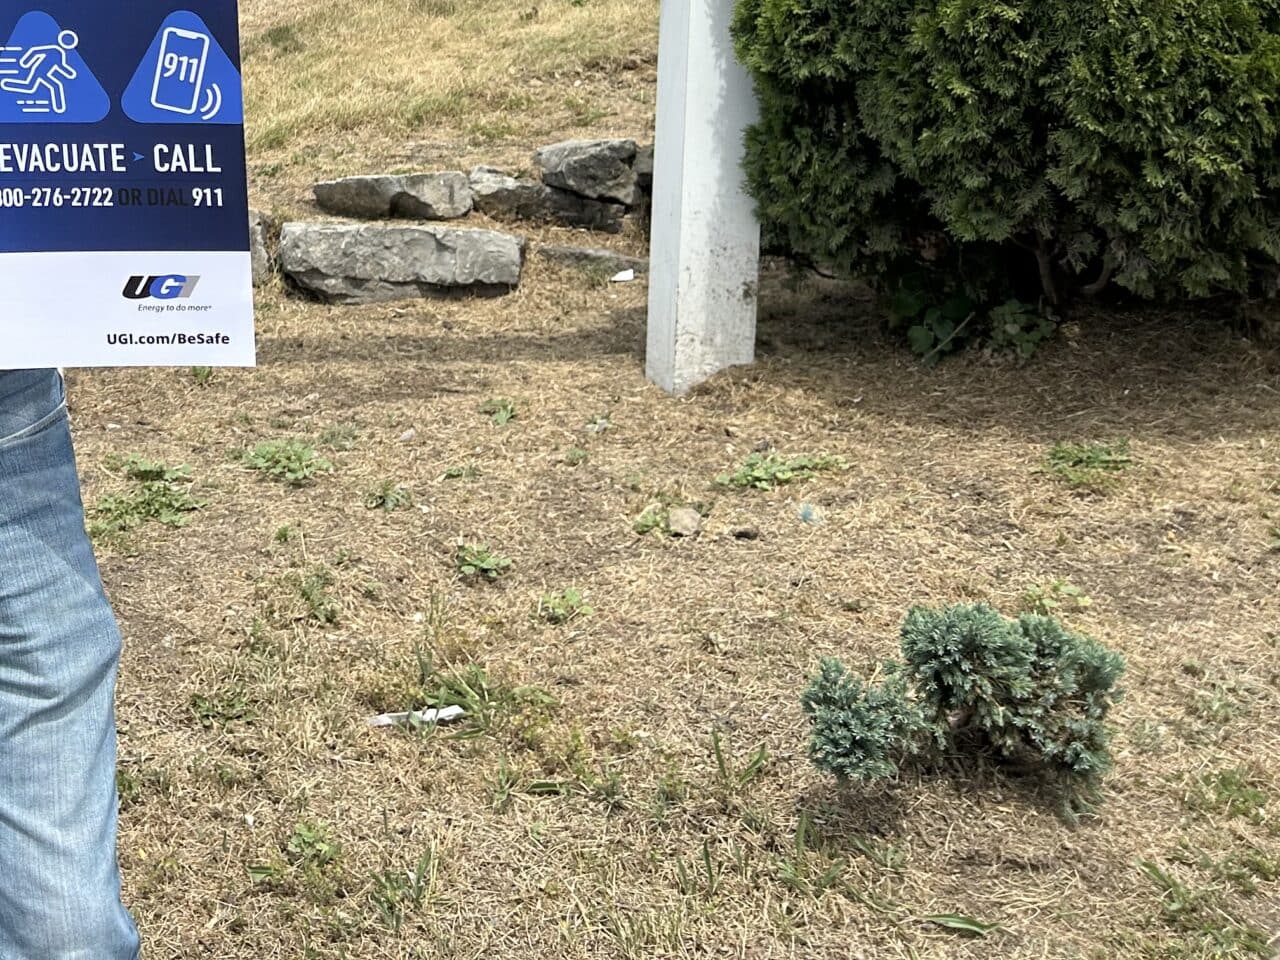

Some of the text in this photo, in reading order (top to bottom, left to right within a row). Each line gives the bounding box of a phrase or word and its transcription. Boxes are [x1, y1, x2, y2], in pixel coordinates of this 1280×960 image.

[164, 53, 199, 83] 911
[153, 143, 221, 173] CALL
[118, 189, 142, 206] OR
[146, 189, 190, 206] DIAL
[192, 187, 223, 206] 911
[122, 274, 200, 299] UGI
[138, 304, 164, 312] Energy
[107, 333, 230, 345] UGI.com/BeSafe
